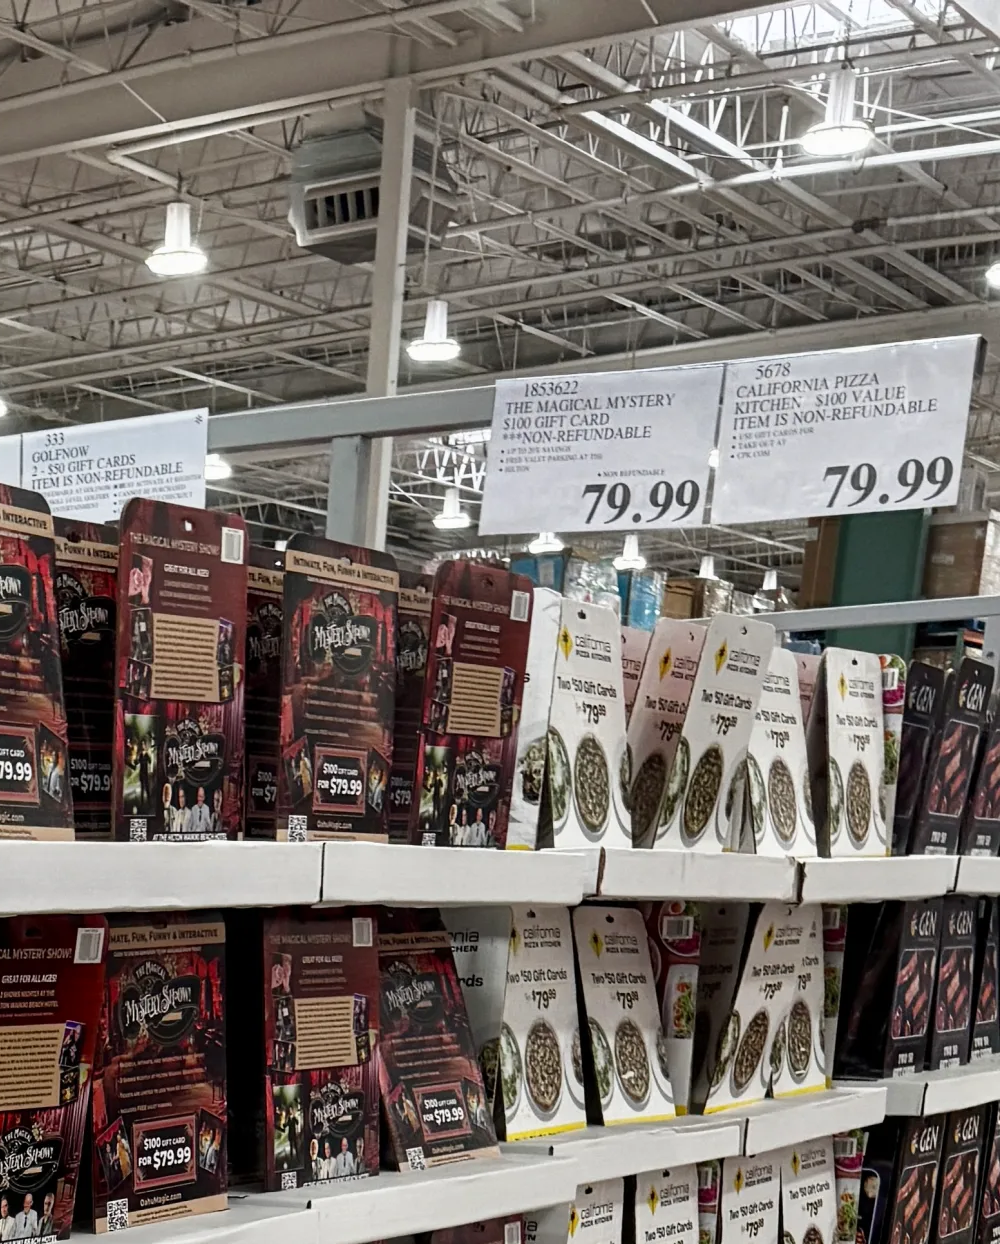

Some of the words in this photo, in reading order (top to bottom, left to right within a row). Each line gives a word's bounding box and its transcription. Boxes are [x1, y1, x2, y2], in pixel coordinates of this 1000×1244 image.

[755, 362, 791, 379] 5678
[524, 381, 579, 398] 1853622
[736, 377, 829, 398] CALIFORNIA
[834, 373, 880, 389] PIZZA
[506, 401, 533, 415] THE
[537, 398, 604, 413] MAGICAL
[606, 393, 676, 409] MYSTERY
[734, 396, 802, 415] KITCHEN
[815, 392, 847, 407] $100
[851, 386, 906, 402] VALUE
[504, 416, 531, 430] $100
[535, 415, 567, 429] GIFT
[570, 413, 610, 427] CARD
[733, 414, 770, 430] ITEM
[774, 413, 788, 426] IS
[792, 398, 938, 425] NON-REFUNDABLE
[44, 432, 65, 447] 333
[32, 445, 90, 463] GOLFNOW
[67, 460, 94, 472] GIFT
[97, 454, 136, 469] CARDS
[32, 476, 60, 490] ITEM
[63, 475, 73, 487] IS
[75, 461, 183, 485] NON-REFUNDABLE
[823, 456, 953, 508] 79.99
[581, 479, 700, 525] 79.99
[557, 676, 571, 690] Two
[583, 680, 597, 695] Gift
[597, 683, 617, 698] Cards
[918, 910, 938, 936] GEN
[919, 1126, 939, 1153] GEN
